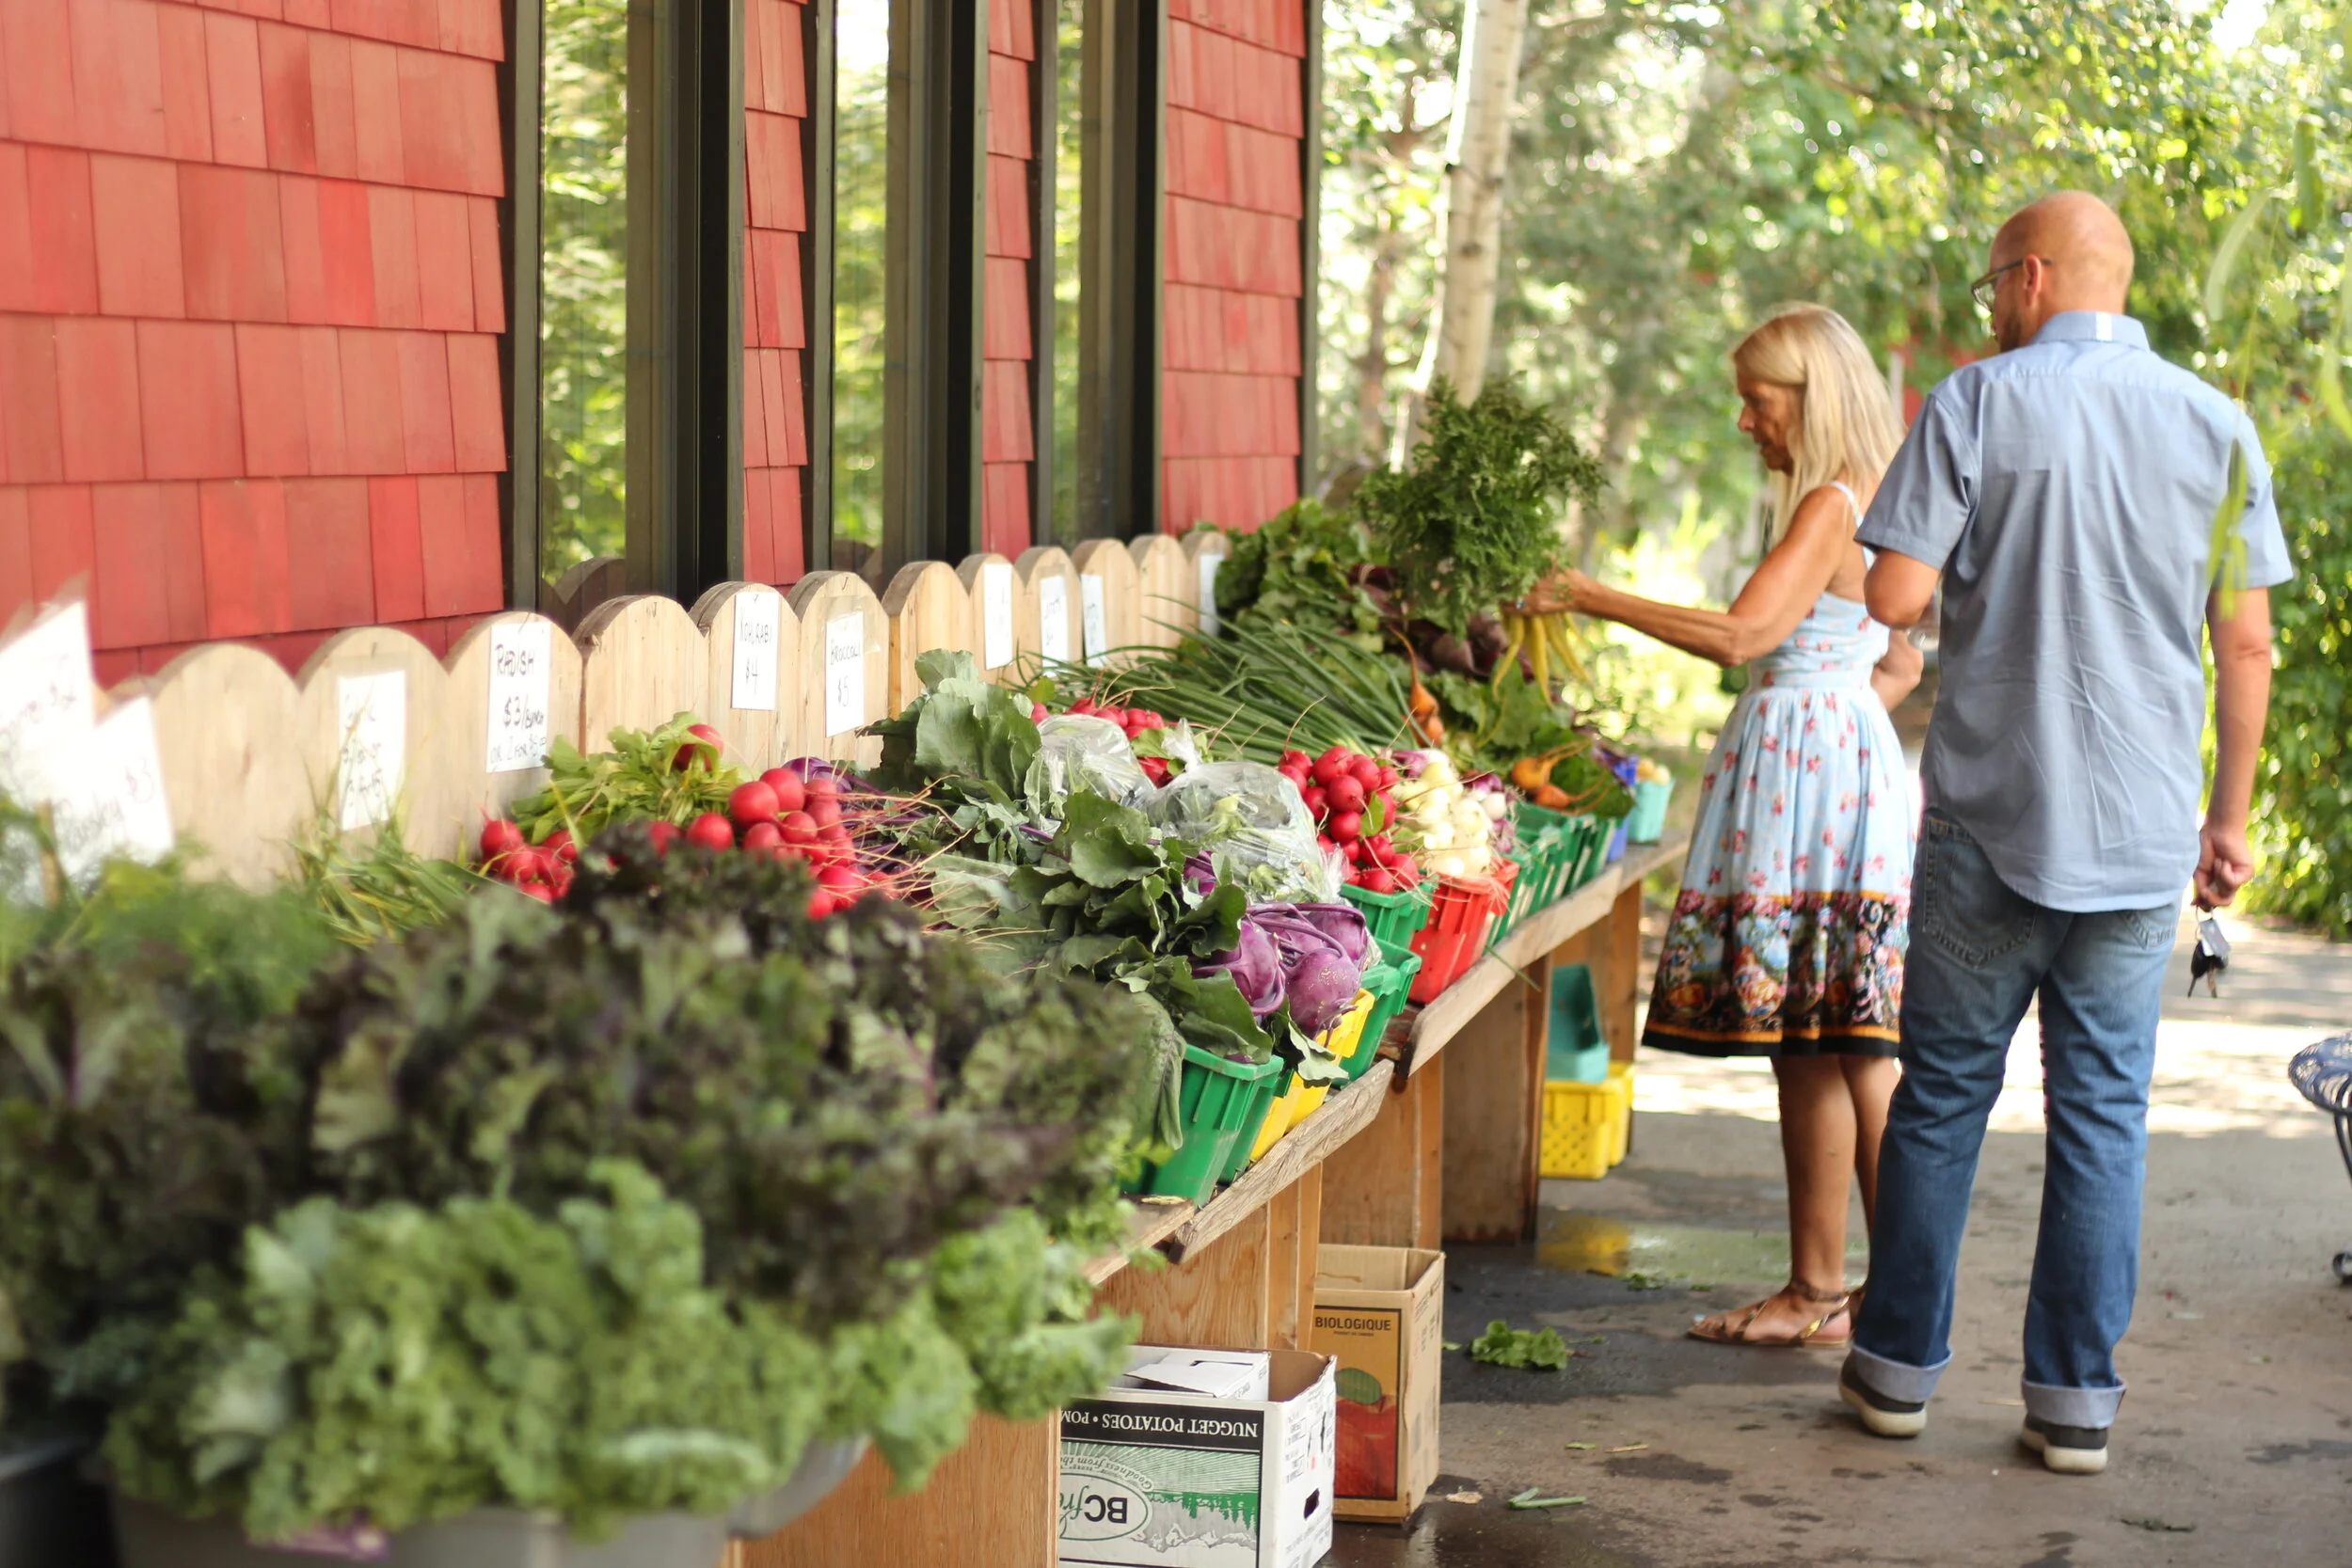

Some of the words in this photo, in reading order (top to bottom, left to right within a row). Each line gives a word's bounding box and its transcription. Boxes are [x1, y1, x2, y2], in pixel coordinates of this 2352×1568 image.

[739, 608, 772, 645] KOHLRABI
[495, 643, 535, 677] RADISH
[830, 640, 861, 666] BROCCOLI
[745, 656, 758, 695] $4
[837, 675, 850, 707] $5
[1315, 1317, 1391, 1331] BIOLOGIQUE
[1102, 1414, 1184, 1433] POTATOES
[1187, 1418, 1258, 1437] NUGGET
[1060, 1456, 1074, 1467] th
[1077, 1458, 1104, 1469] from
[1105, 1463, 1152, 1490] Goodness
